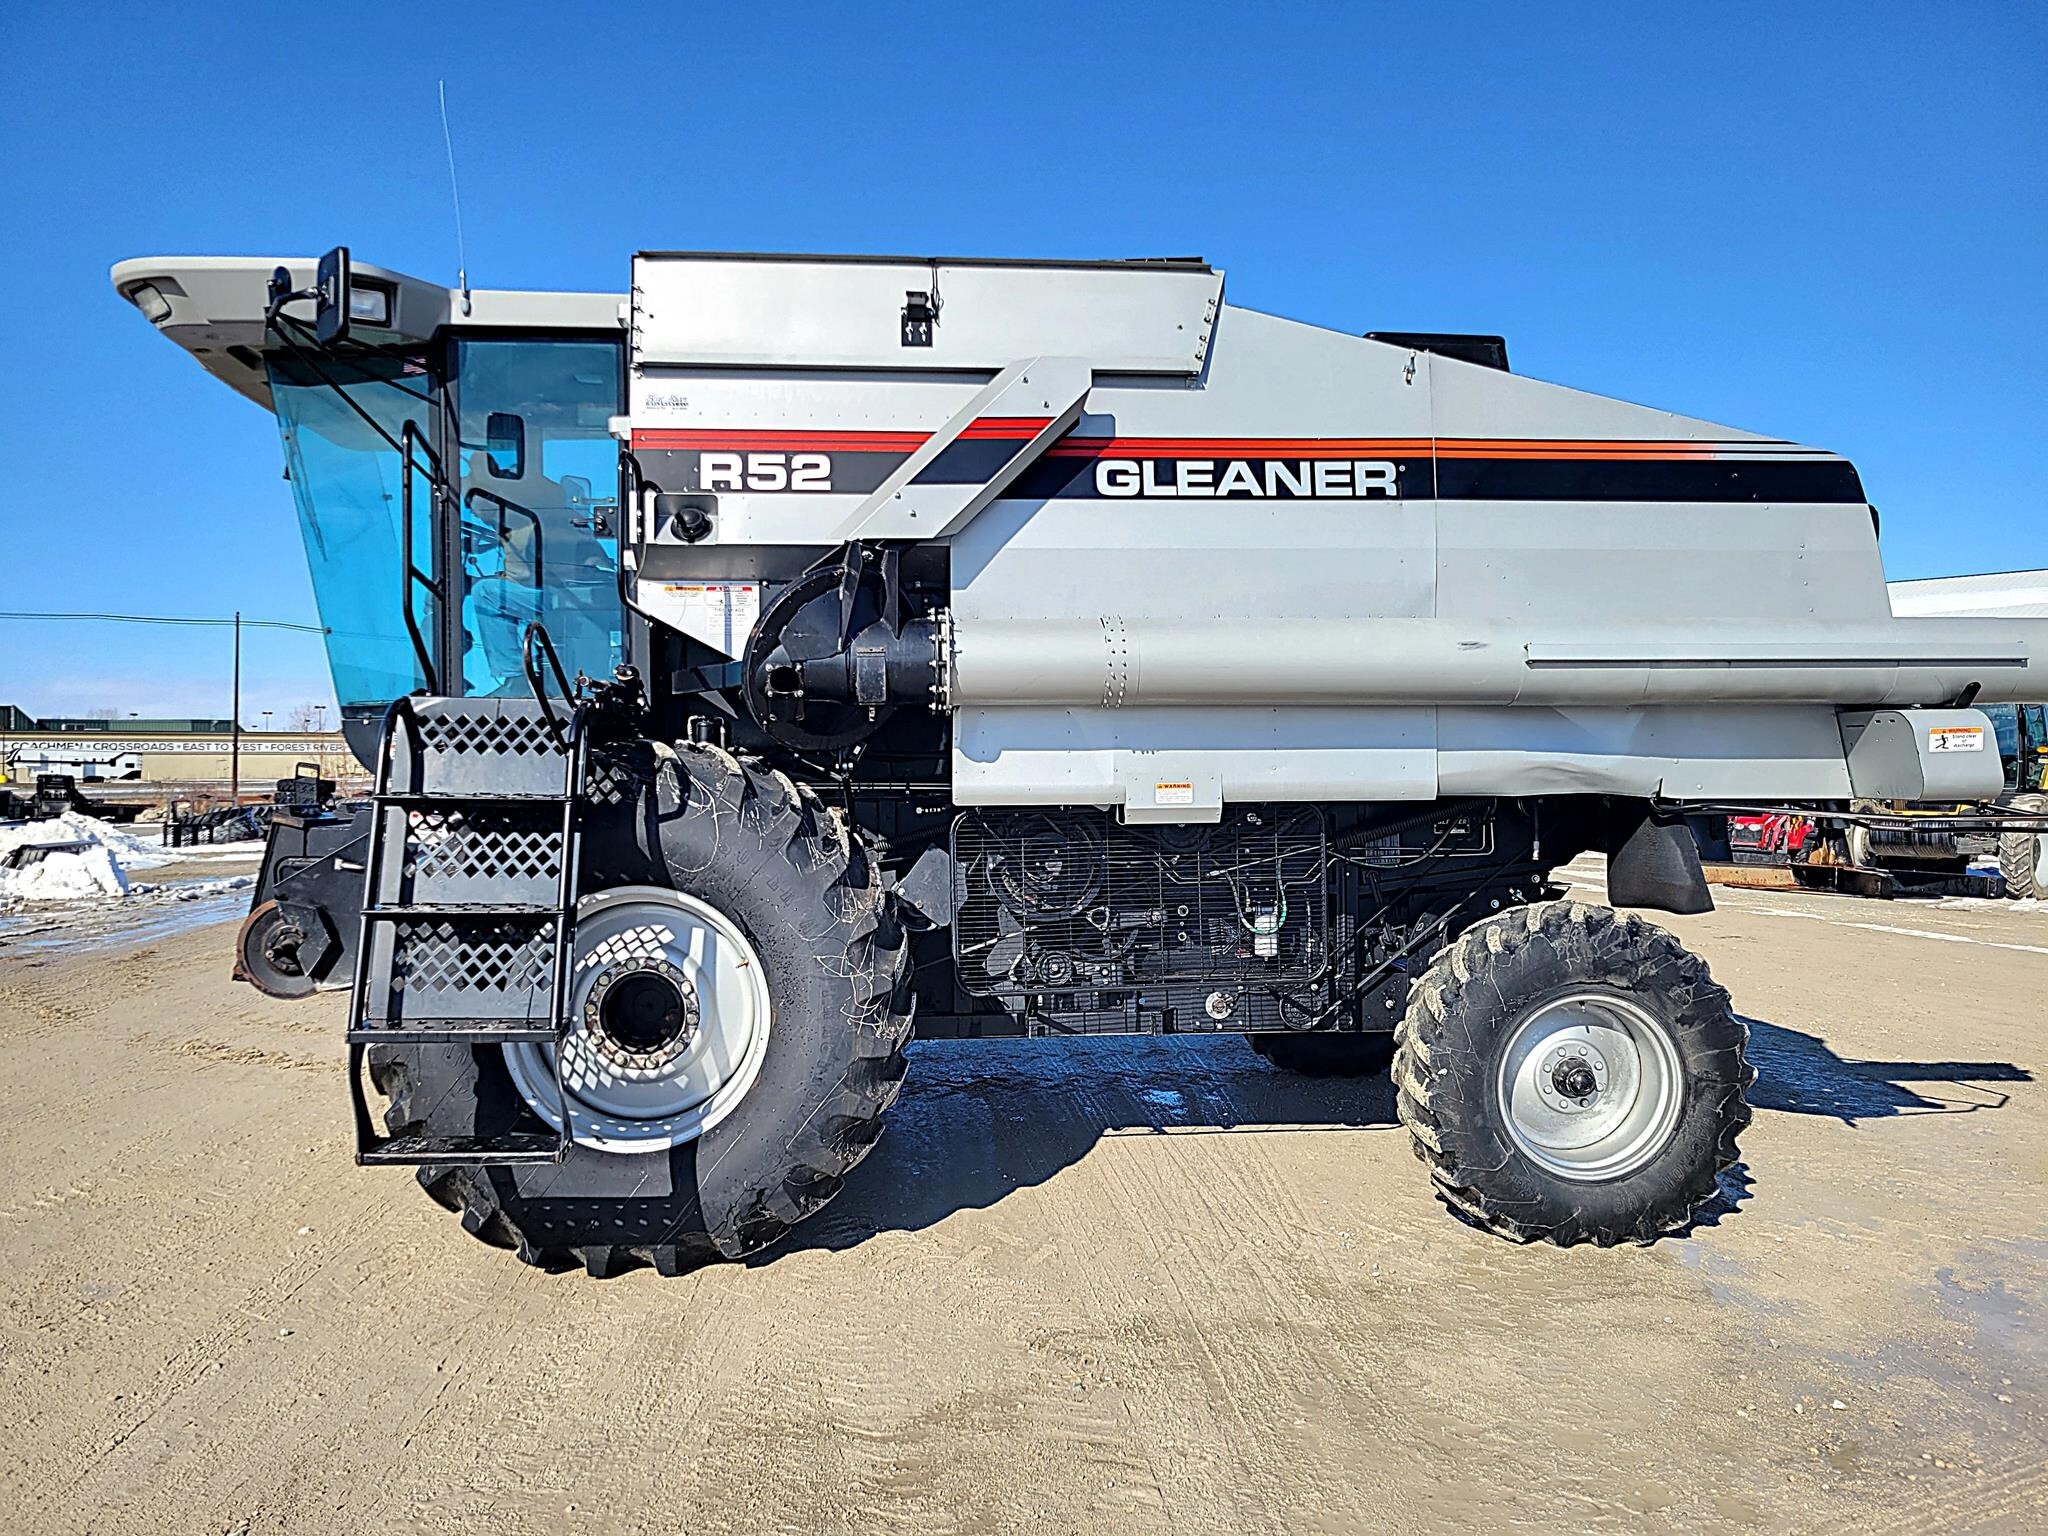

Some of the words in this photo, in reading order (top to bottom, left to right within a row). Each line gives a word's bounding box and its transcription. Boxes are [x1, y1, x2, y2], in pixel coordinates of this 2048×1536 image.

[700, 453, 831, 490] R52
[1095, 460, 1397, 497] GLEANER
[93, 742, 175, 751] CROSSROADS
[182, 743, 211, 751] EAST
[214, 743, 229, 751] TO
[270, 743, 310, 751] FOREST
[312, 743, 343, 751] RIVER
